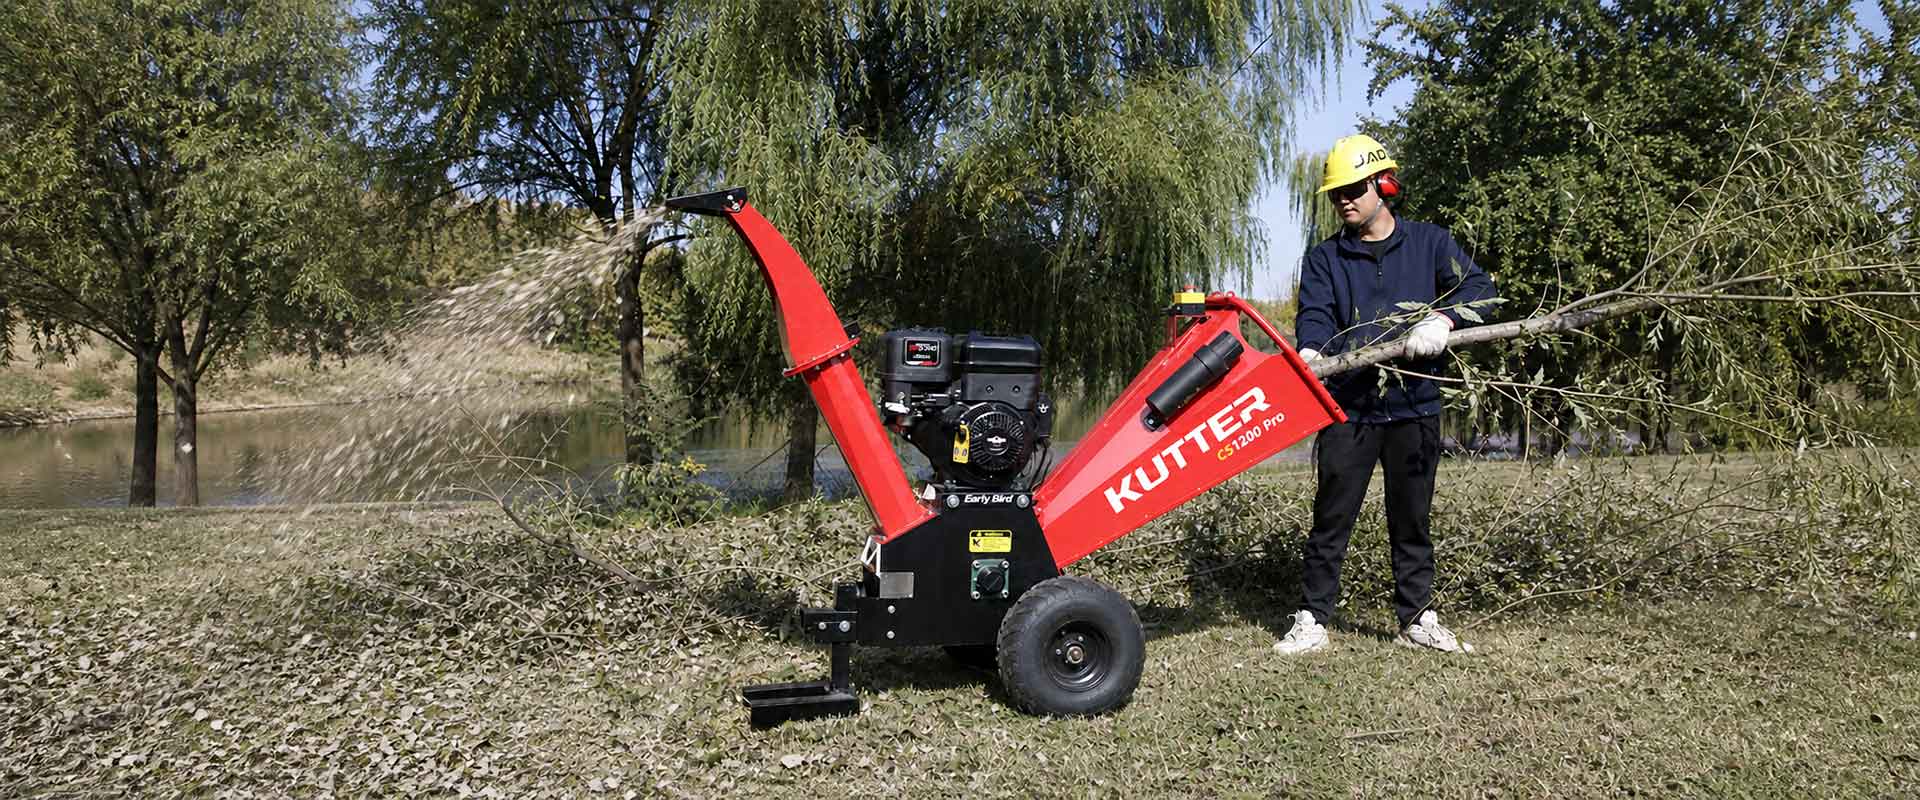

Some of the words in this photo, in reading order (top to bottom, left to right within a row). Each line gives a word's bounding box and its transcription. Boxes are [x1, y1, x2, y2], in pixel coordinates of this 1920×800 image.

[1103, 387, 1271, 514] KUTTER
[1216, 425, 1262, 461] CS1200
[1263, 412, 1285, 432] Pro
[964, 494, 991, 505] Early
[992, 494, 1015, 503] Bird
